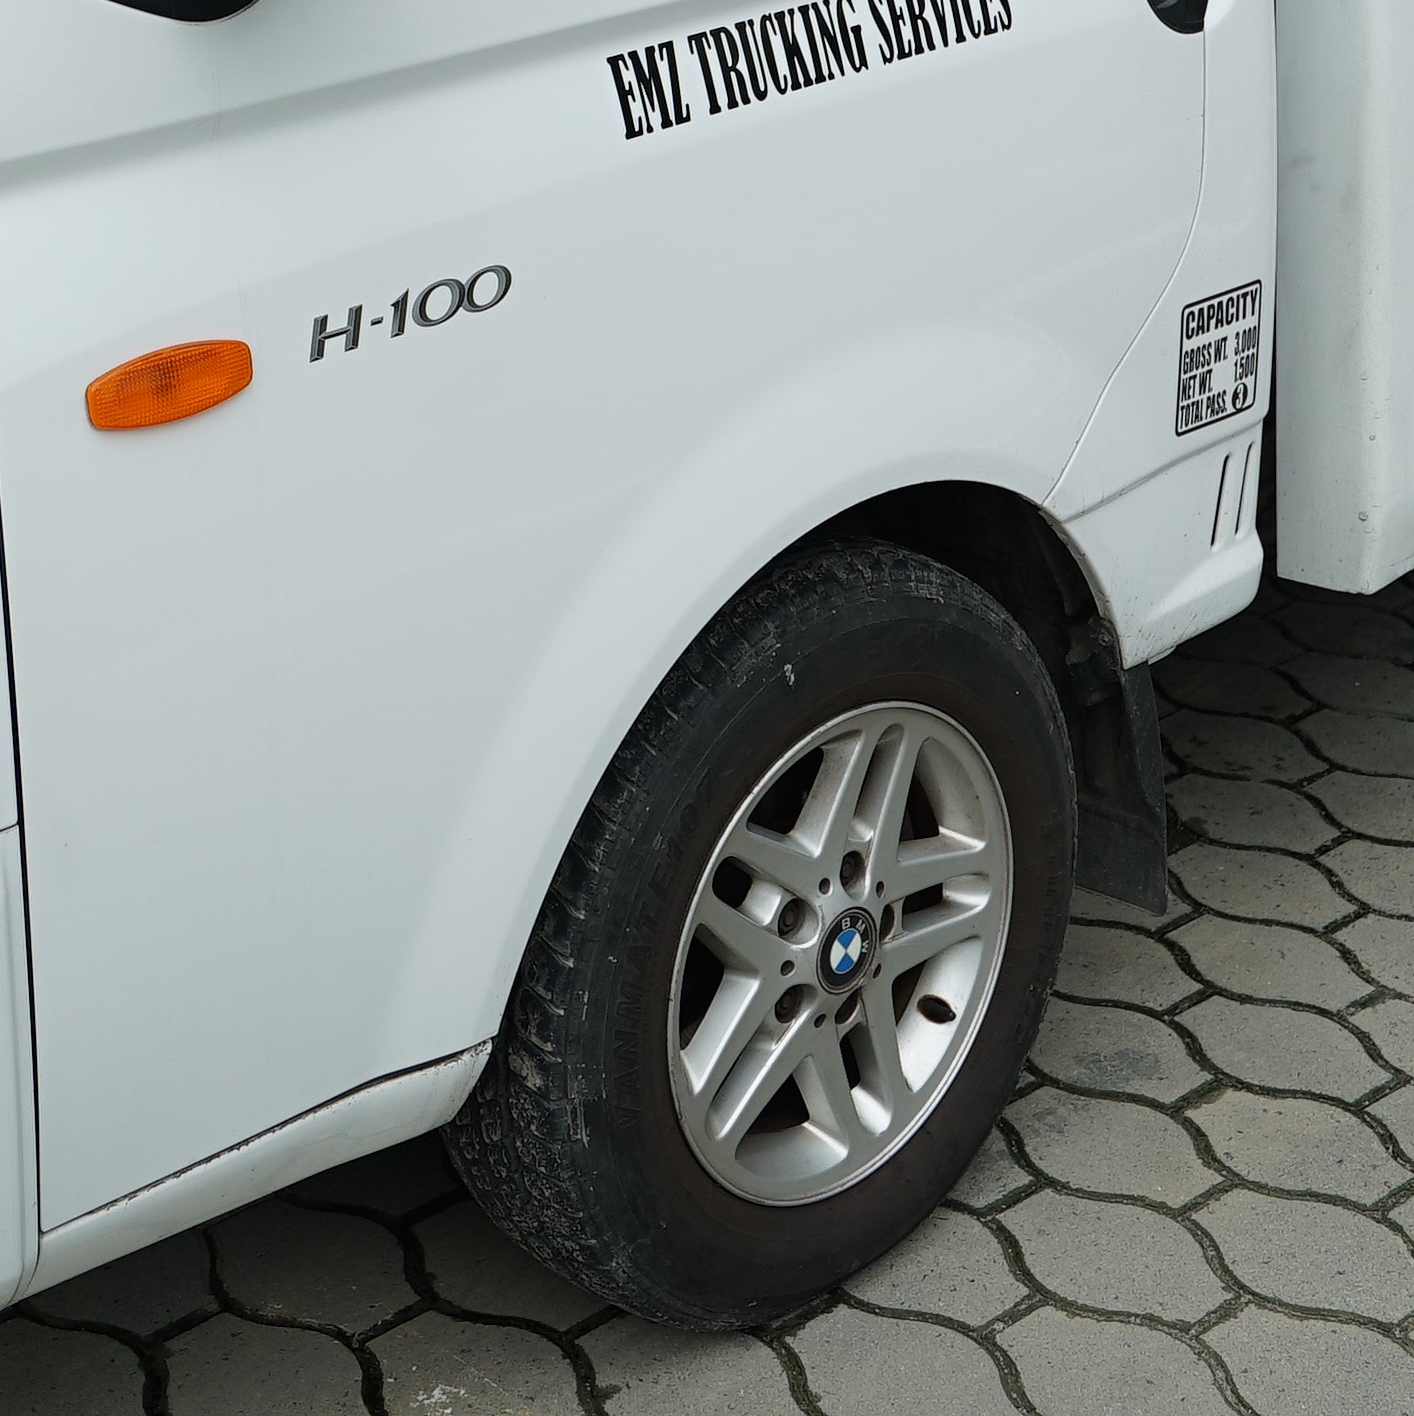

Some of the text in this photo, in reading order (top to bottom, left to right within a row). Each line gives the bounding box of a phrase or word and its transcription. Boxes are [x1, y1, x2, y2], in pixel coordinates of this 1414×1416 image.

[605, 39, 692, 141] EMZ
[308, 263, 513, 364] H-100
[1186, 287, 1258, 340] CAPACITY
[1183, 342, 1212, 375] GROSS
[1181, 375, 1197, 403] NET
[1180, 400, 1203, 429] TOTAL
[841, 916, 870, 954] BMW
